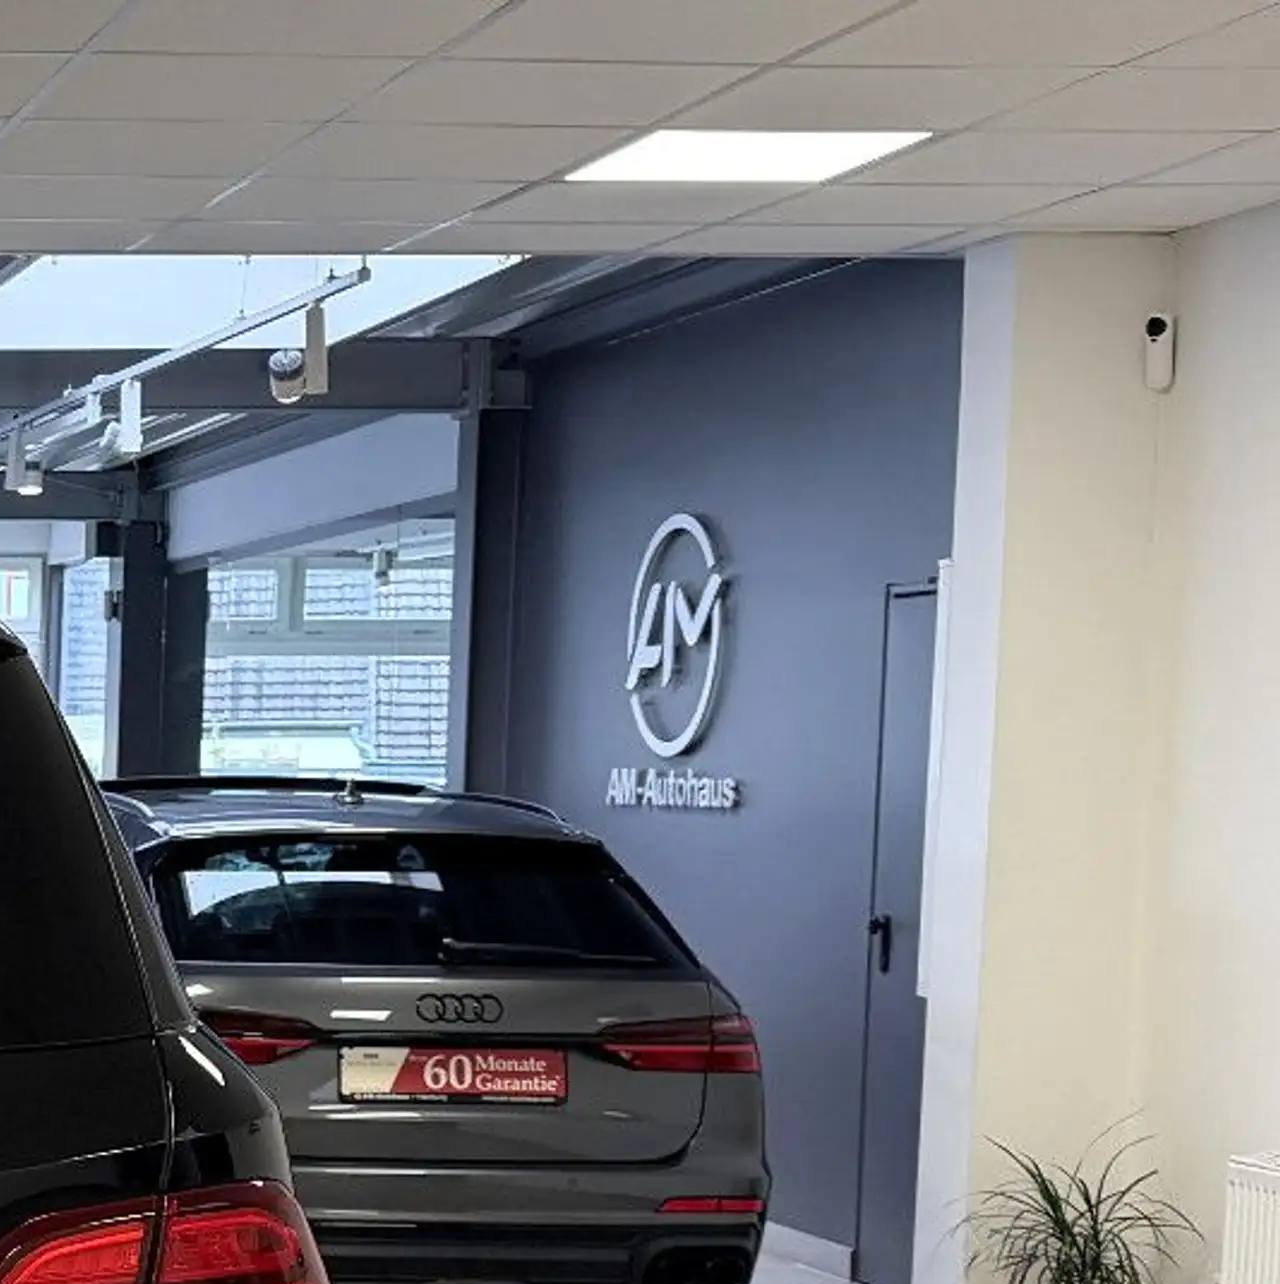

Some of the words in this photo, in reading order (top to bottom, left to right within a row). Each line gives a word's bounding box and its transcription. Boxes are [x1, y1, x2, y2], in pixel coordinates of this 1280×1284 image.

[606, 767, 737, 809] AM-Autohaus
[423, 1054, 473, 1090] 60
[475, 1055, 547, 1072] Monate
